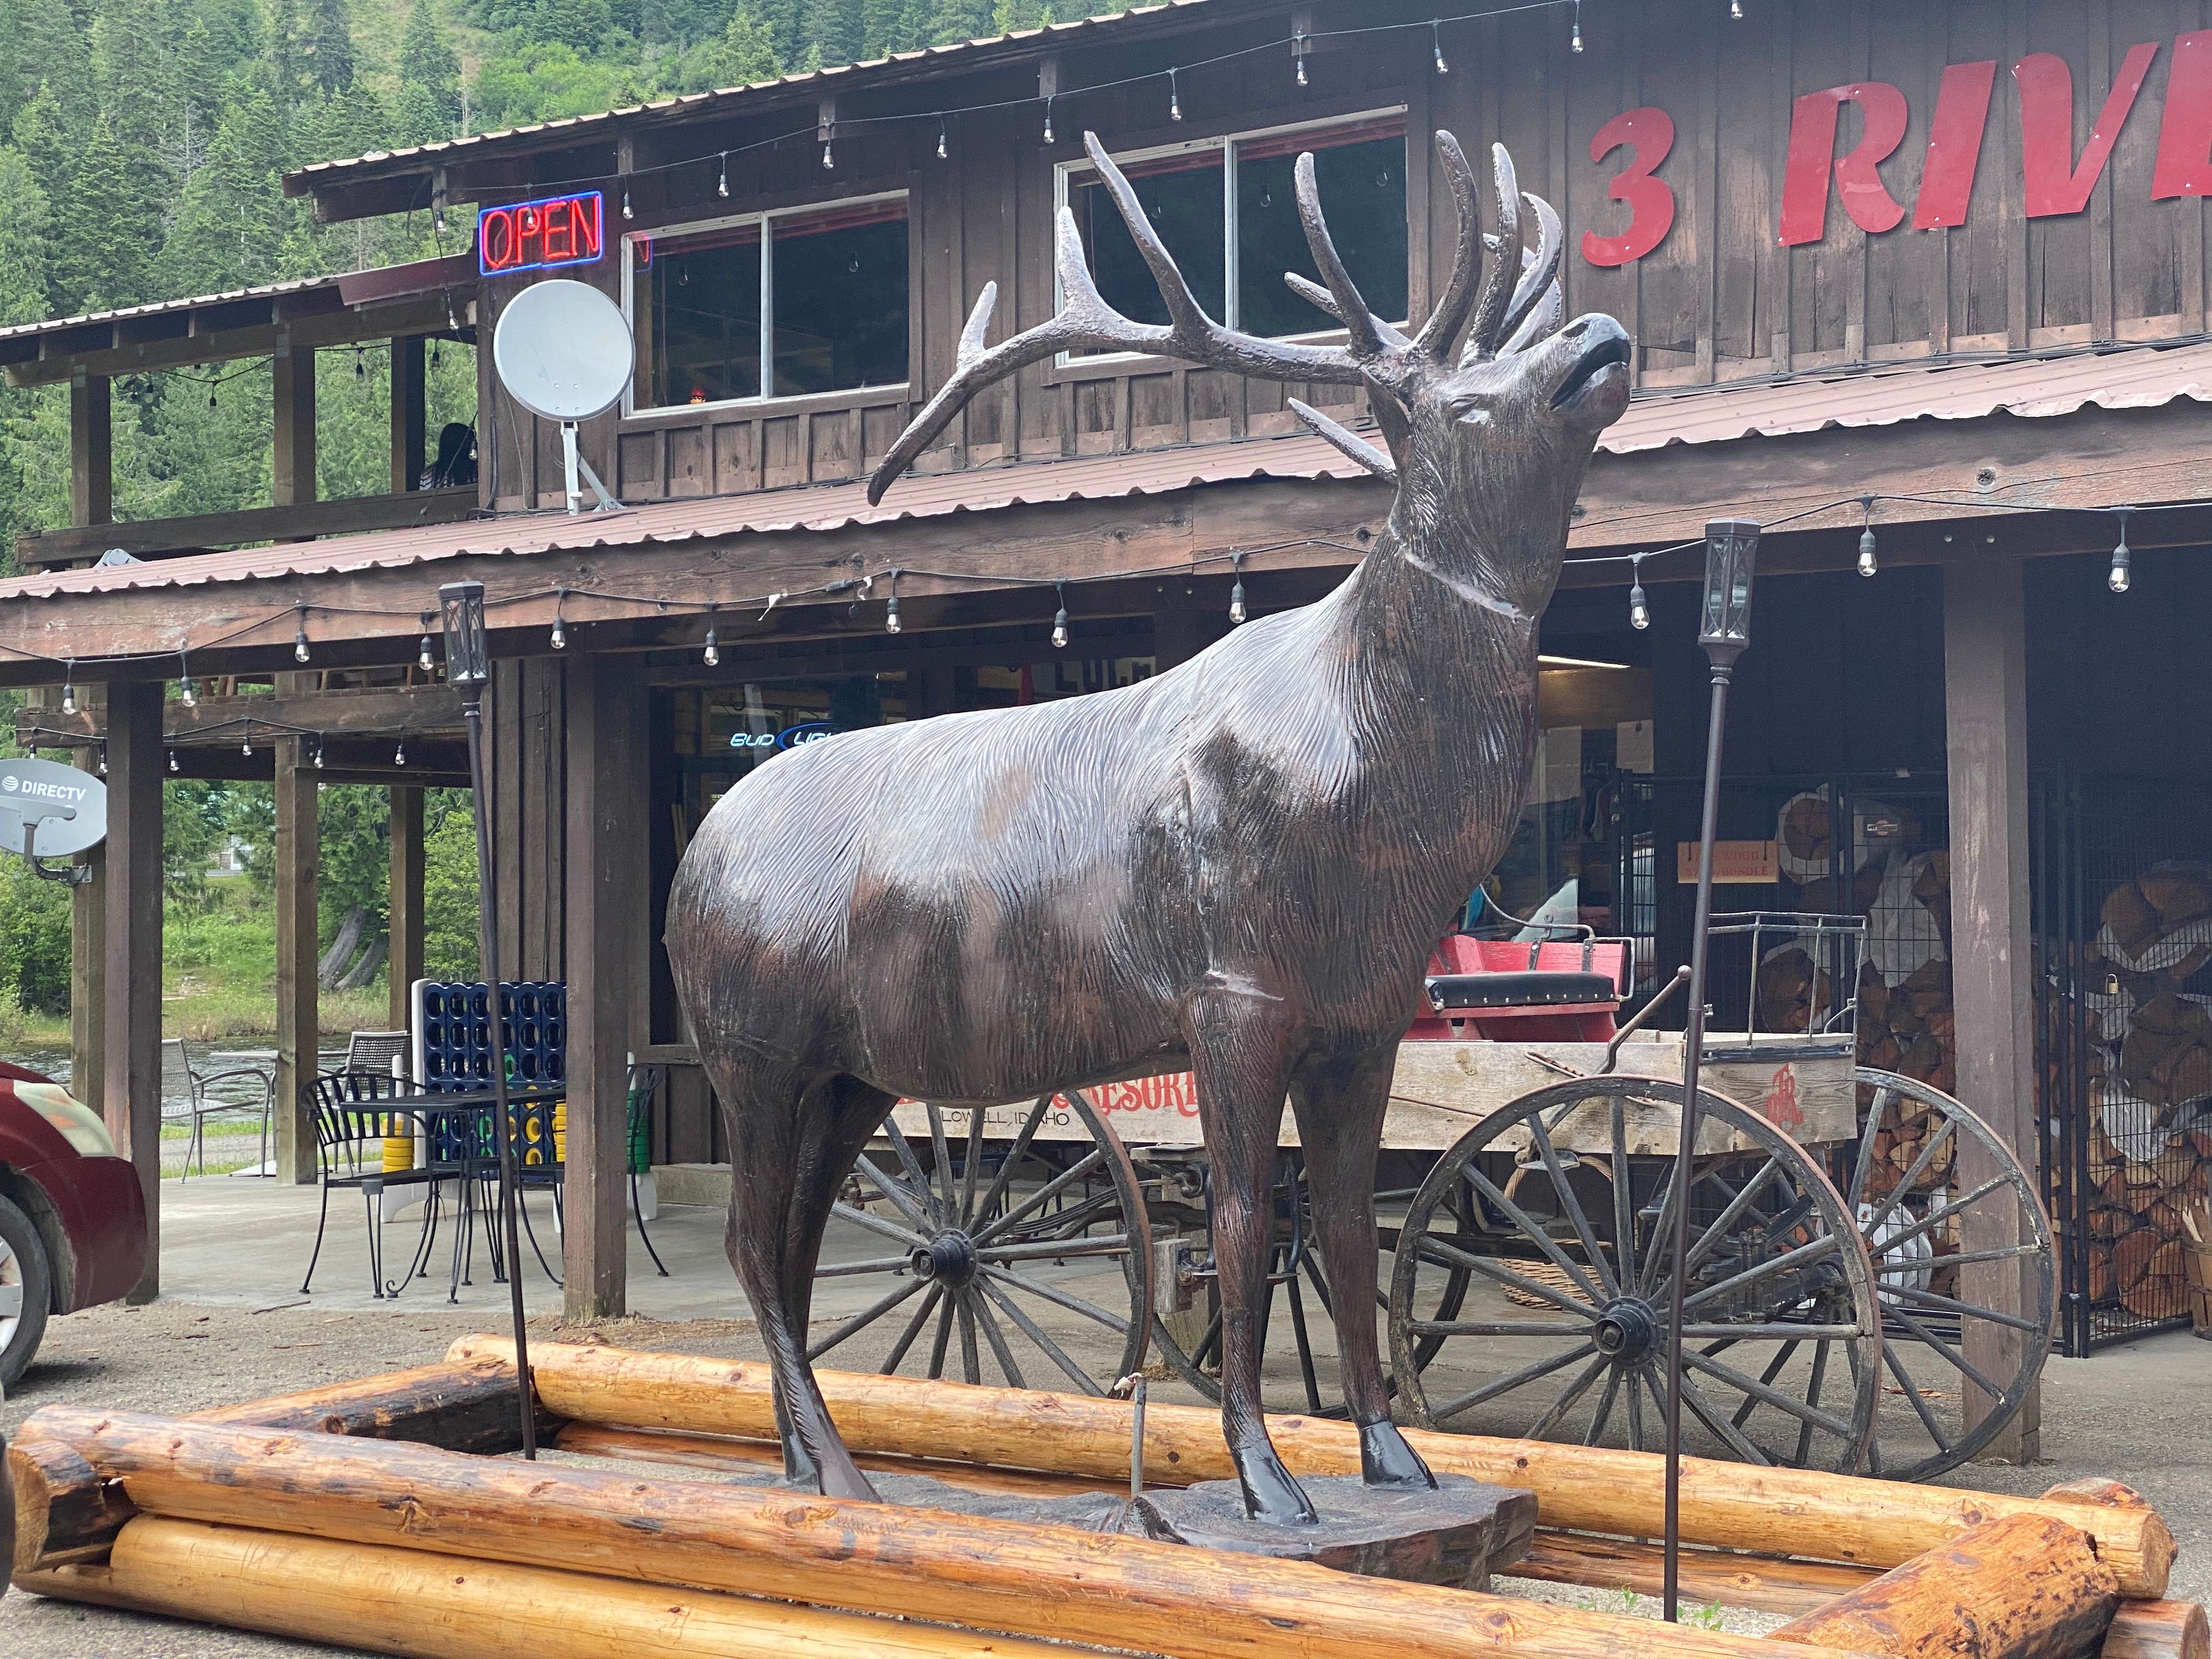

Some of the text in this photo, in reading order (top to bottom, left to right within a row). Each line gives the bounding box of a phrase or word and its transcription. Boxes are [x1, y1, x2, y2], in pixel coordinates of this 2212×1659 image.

[1581, 107, 1674, 266] 3
[483, 195, 599, 268] OPEN
[730, 733, 775, 747] BUD
[21, 781, 87, 800] DIRECTV
[941, 1111, 1069, 1126] LOWLL, IDHO
